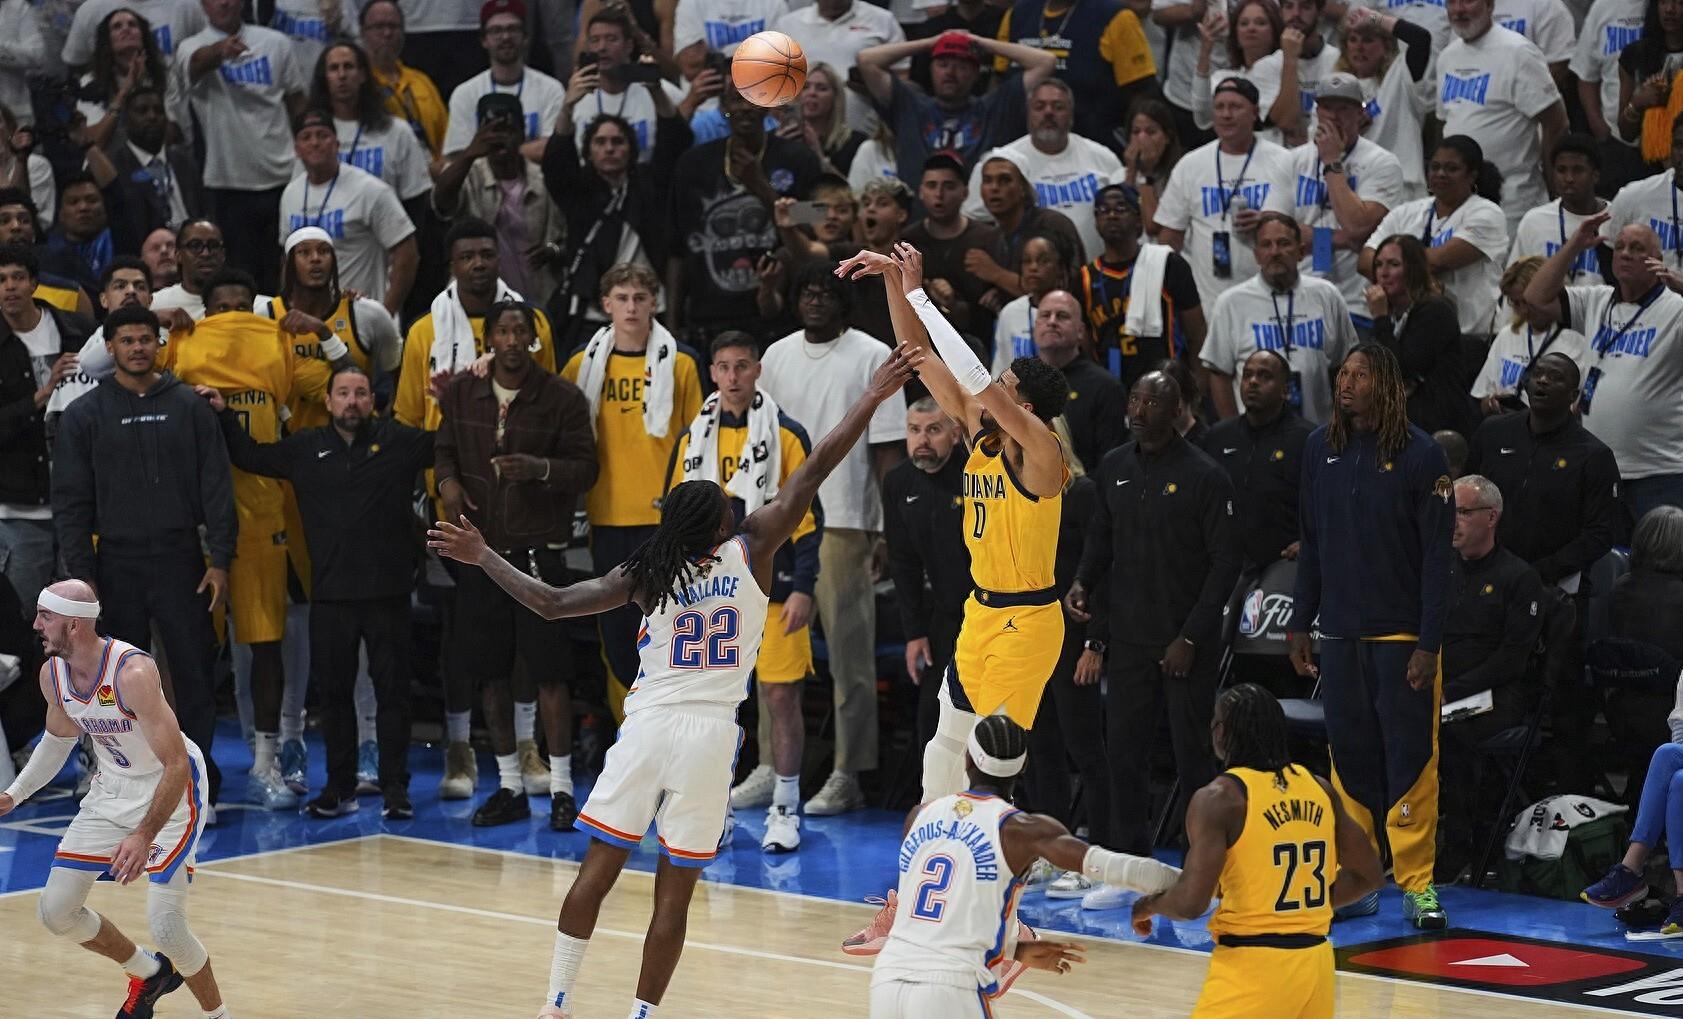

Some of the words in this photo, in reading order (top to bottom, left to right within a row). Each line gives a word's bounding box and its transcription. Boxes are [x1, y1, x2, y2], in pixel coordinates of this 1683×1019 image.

[678, 576, 739, 608] WALLACE
[669, 605, 740, 669] 22
[1263, 799, 1324, 831] NESMITH
[911, 853, 956, 923] 2
[1273, 839, 1327, 913] 23
